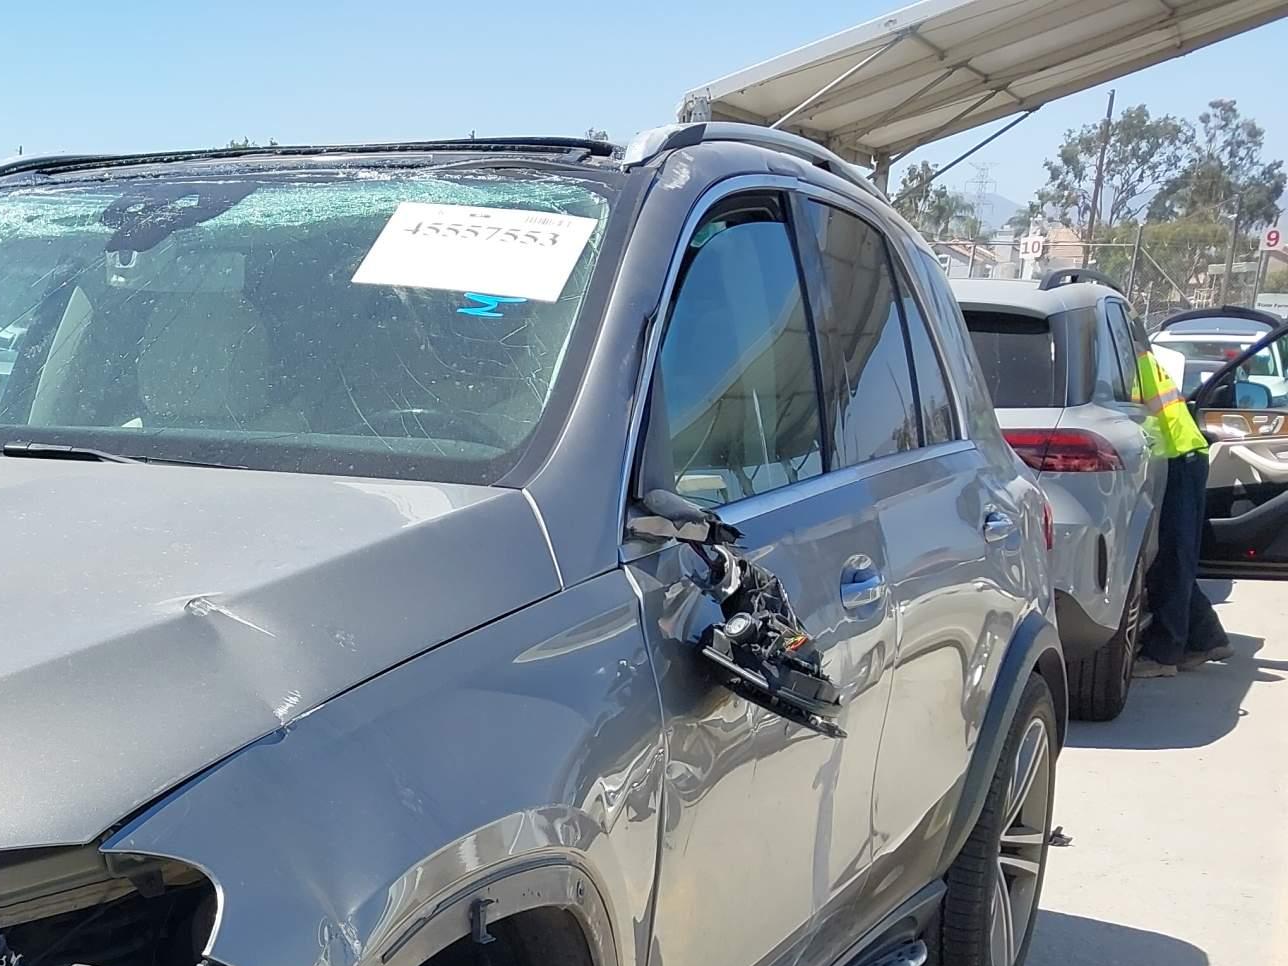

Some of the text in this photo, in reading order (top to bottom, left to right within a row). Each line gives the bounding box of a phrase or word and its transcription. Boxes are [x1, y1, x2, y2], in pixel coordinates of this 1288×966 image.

[403, 220, 562, 247] 45557553
[1266, 230, 1280, 248] 9
[1020, 240, 1042, 255] 10
